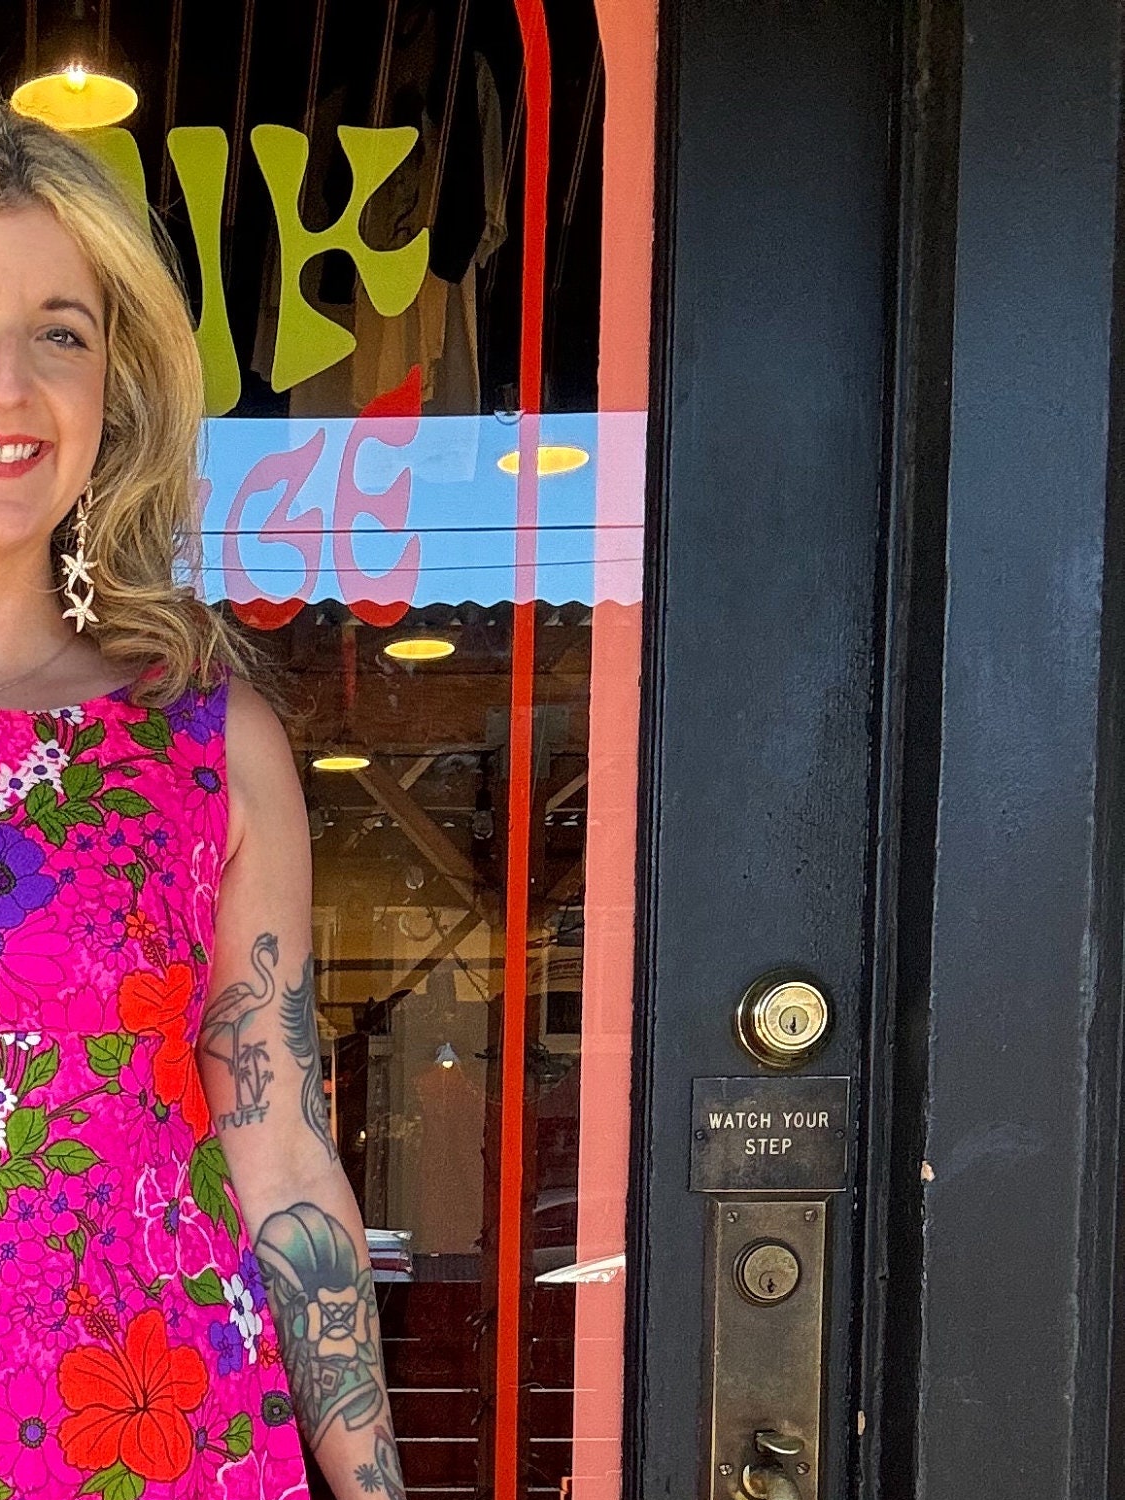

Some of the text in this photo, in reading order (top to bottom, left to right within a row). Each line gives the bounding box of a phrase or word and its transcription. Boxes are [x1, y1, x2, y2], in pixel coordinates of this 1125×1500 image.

[708, 1111, 829, 1129] WATCH YOUR
[745, 1138, 792, 1155] STEP
